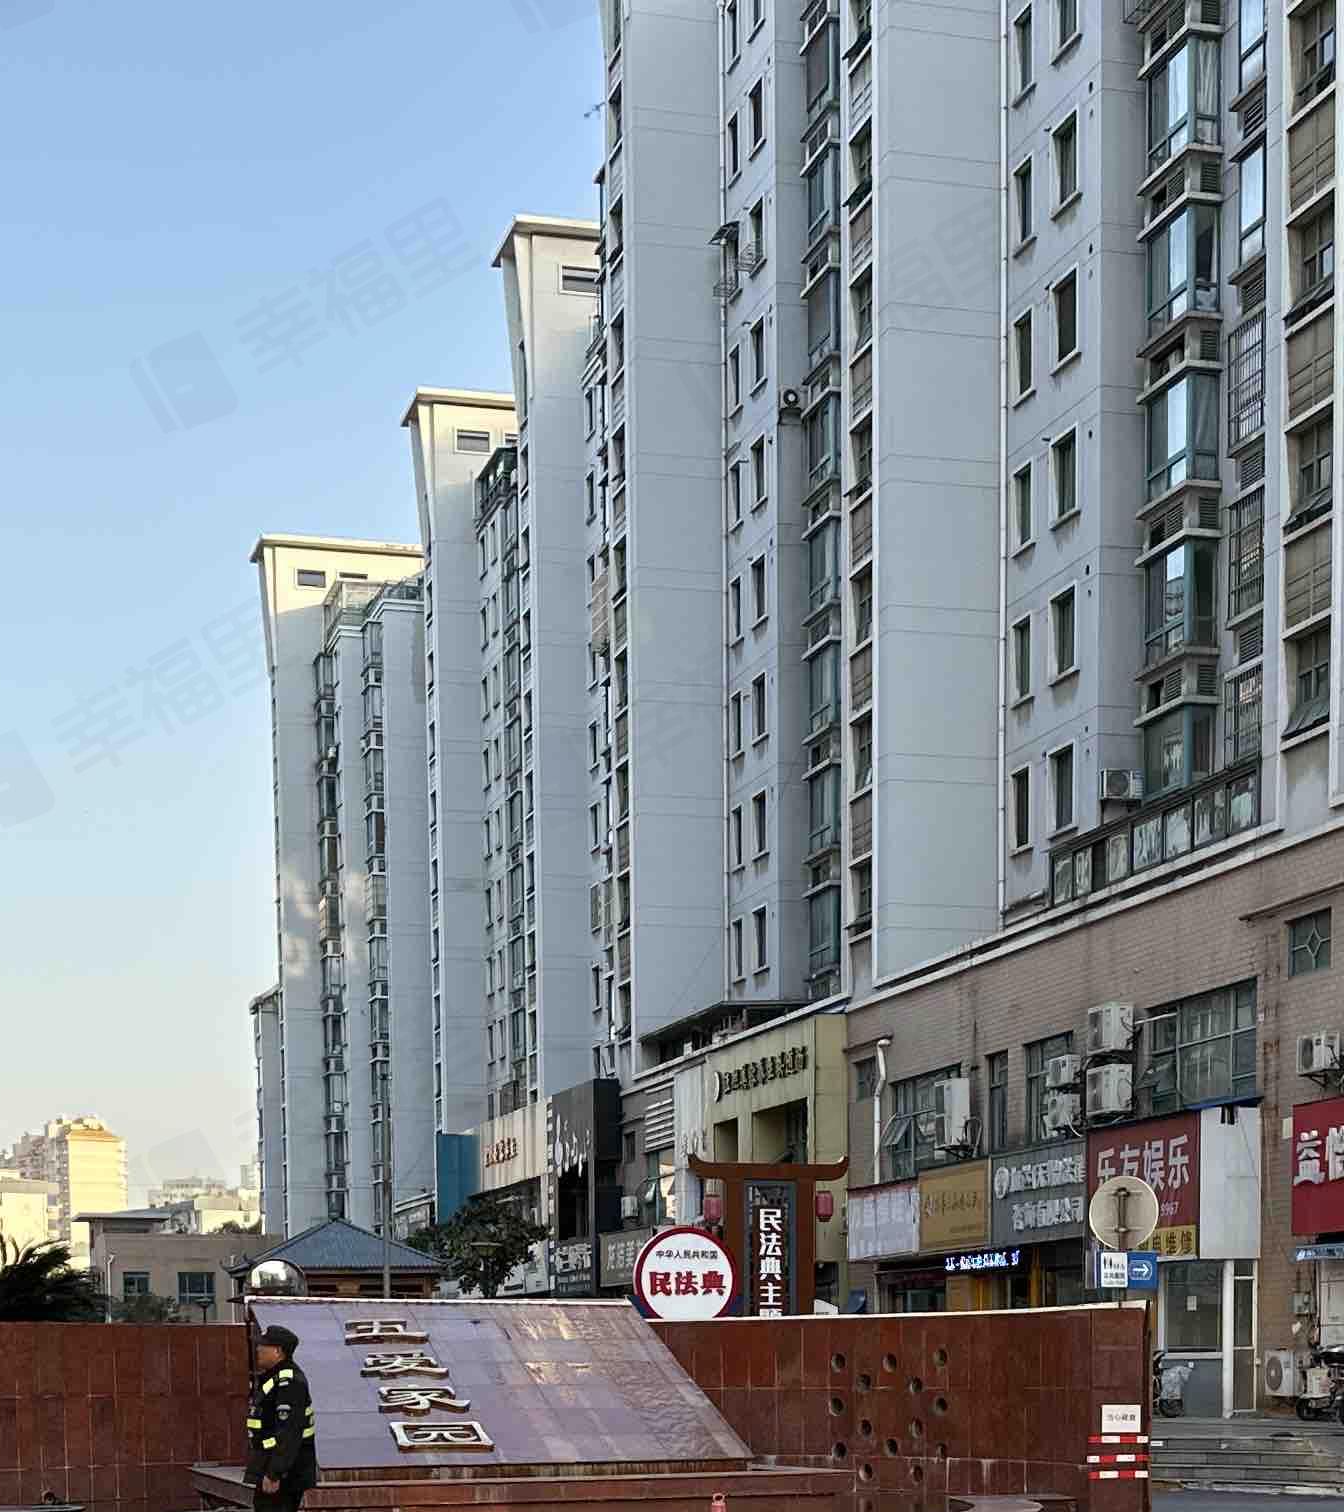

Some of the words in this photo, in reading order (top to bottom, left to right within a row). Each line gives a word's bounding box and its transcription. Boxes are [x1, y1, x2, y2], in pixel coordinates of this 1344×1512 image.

[655, 1249, 719, 1260] 中华人民共和国
[649, 1270, 726, 1297] 民法典
[344, 1319, 497, 1454] 五爱家园
